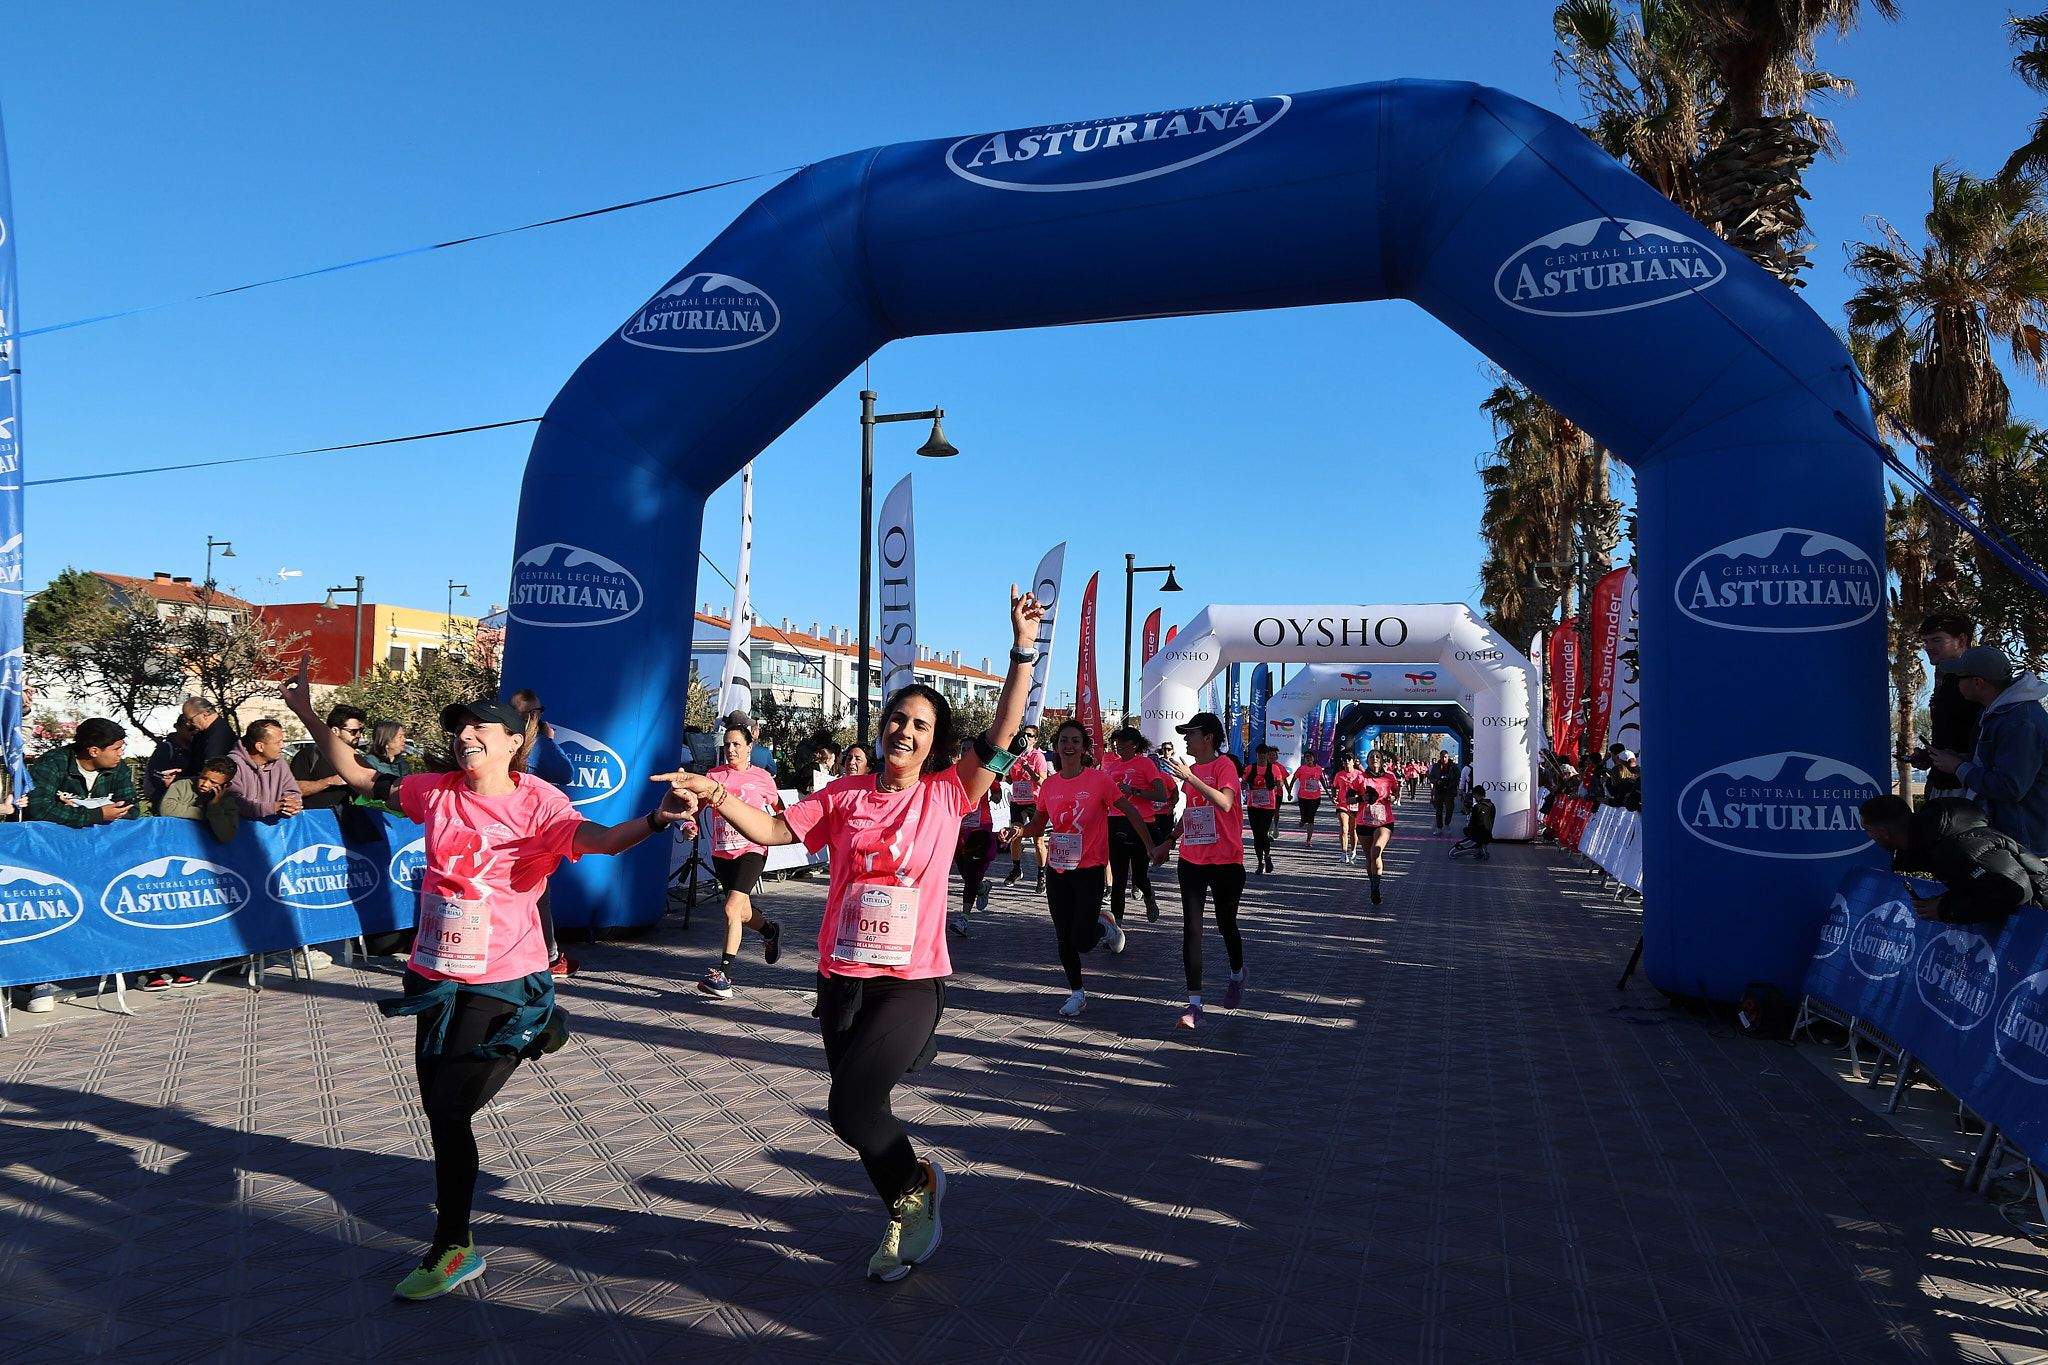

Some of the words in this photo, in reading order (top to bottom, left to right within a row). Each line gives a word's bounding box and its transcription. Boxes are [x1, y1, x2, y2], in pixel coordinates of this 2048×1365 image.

[966, 103, 1262, 168] ASTURIANA
[1544, 248, 1621, 267] CENTRAL
[1628, 245, 1699, 256] LECHERA
[1512, 257, 1714, 301] ASTURIANA
[654, 298, 699, 311] CENTRAL
[704, 297, 761, 307] LECHERA
[626, 309, 767, 336] ASTURIANA
[519, 571, 563, 580] CENTRAL
[567, 573, 626, 586] LECHERA
[1722, 564, 1800, 577] CENTRAL
[1808, 563, 1870, 576] LECHERA
[509, 575, 630, 612] ASTURIANA
[1688, 570, 1875, 609] ASTURIANA
[882, 525, 914, 704] YSHO
[1083, 599, 1093, 679] Santander
[1253, 616, 1408, 648] OYSHO
[1599, 593, 1622, 689] Santander
[1165, 651, 1209, 662] OYSHO
[1454, 650, 1504, 661] OYSHO
[1563, 640, 1574, 708] Santander
[1144, 709, 1184, 720] OYSHO
[1373, 710, 1442, 718] VOLVO
[1481, 716, 1528, 727] OYSHO
[1481, 780, 1527, 792] OYSHO
[1726, 787, 1804, 799] CENTRAL
[1813, 788, 1874, 799] LECHERA
[1692, 789, 1868, 831] ASTURIAN
[4, 888, 62, 898] LECHERA
[136, 881, 185, 891] CENTRAL
[277, 871, 373, 897] ASTURIANA
[115, 885, 242, 915] ASTURIANA
[860, 919, 890, 934] 016
[436, 929, 462, 944] 016
